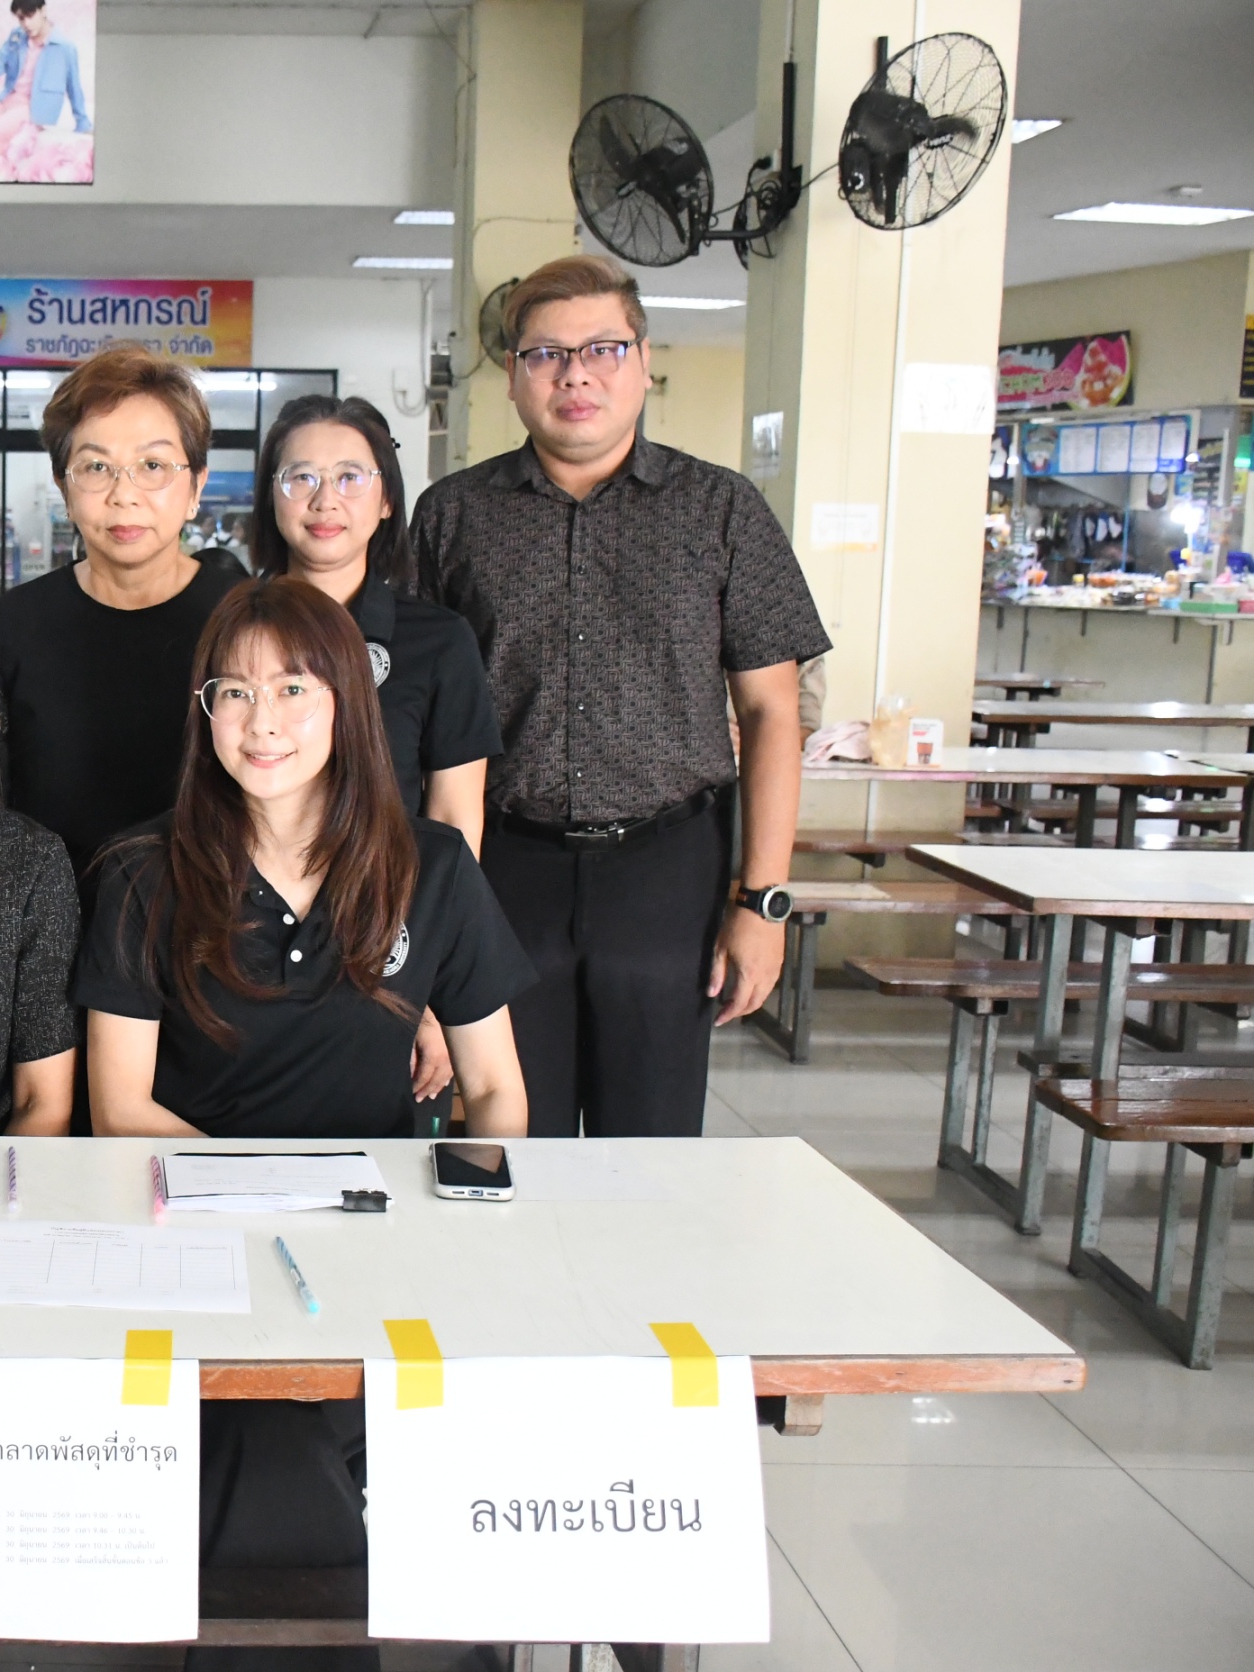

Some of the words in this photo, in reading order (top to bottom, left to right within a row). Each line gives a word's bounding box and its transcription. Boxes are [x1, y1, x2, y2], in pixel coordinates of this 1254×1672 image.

[27, 288, 209, 326] ร้านสหกรณ์
[470, 1479, 702, 1533] ลงทะเบียน
